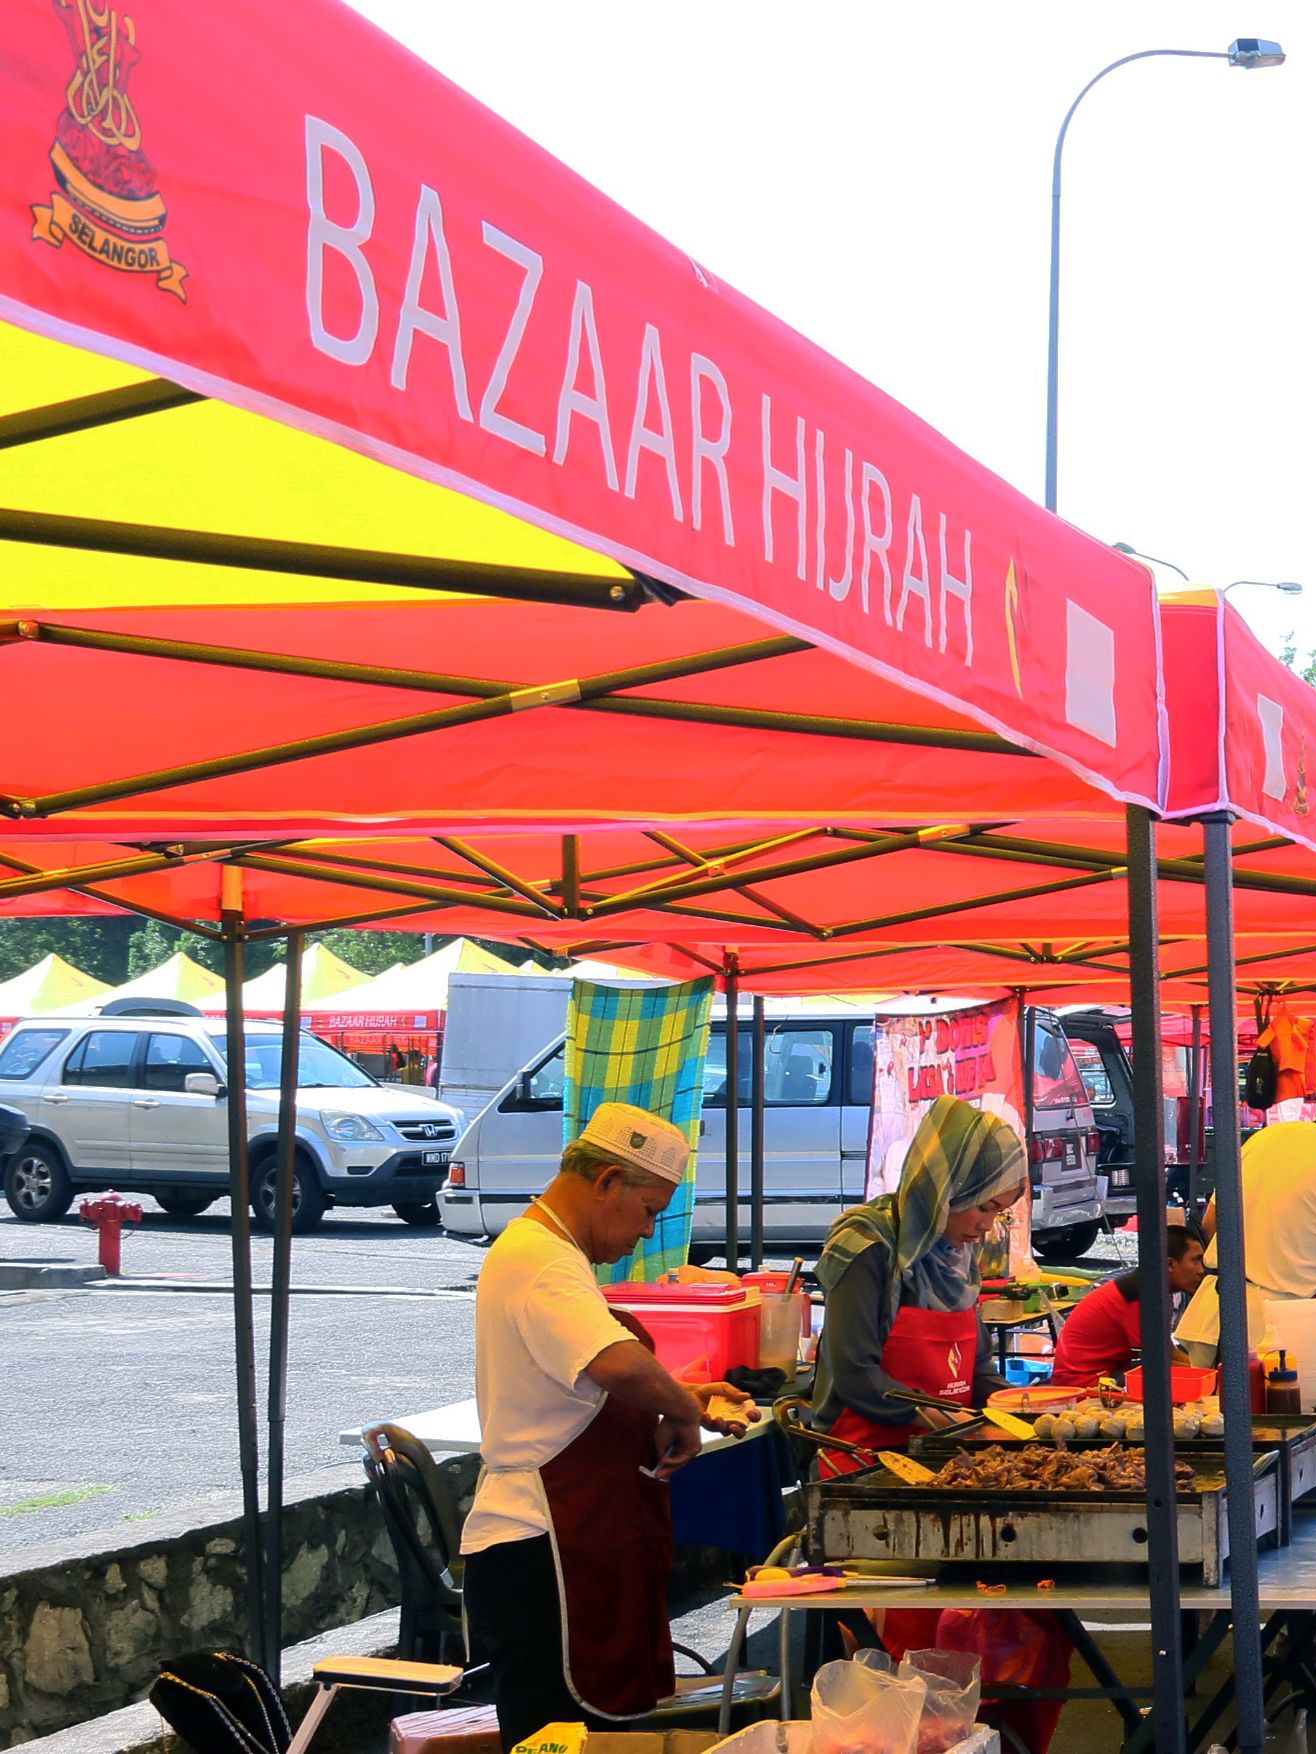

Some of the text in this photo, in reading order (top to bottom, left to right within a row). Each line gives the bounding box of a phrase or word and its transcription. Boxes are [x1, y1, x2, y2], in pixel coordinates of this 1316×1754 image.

[66, 212, 162, 270] SELANGOR
[304, 114, 974, 668] BAZAAR HIJRAH
[328, 1015, 397, 1028] BAZAAR HIJRAH
